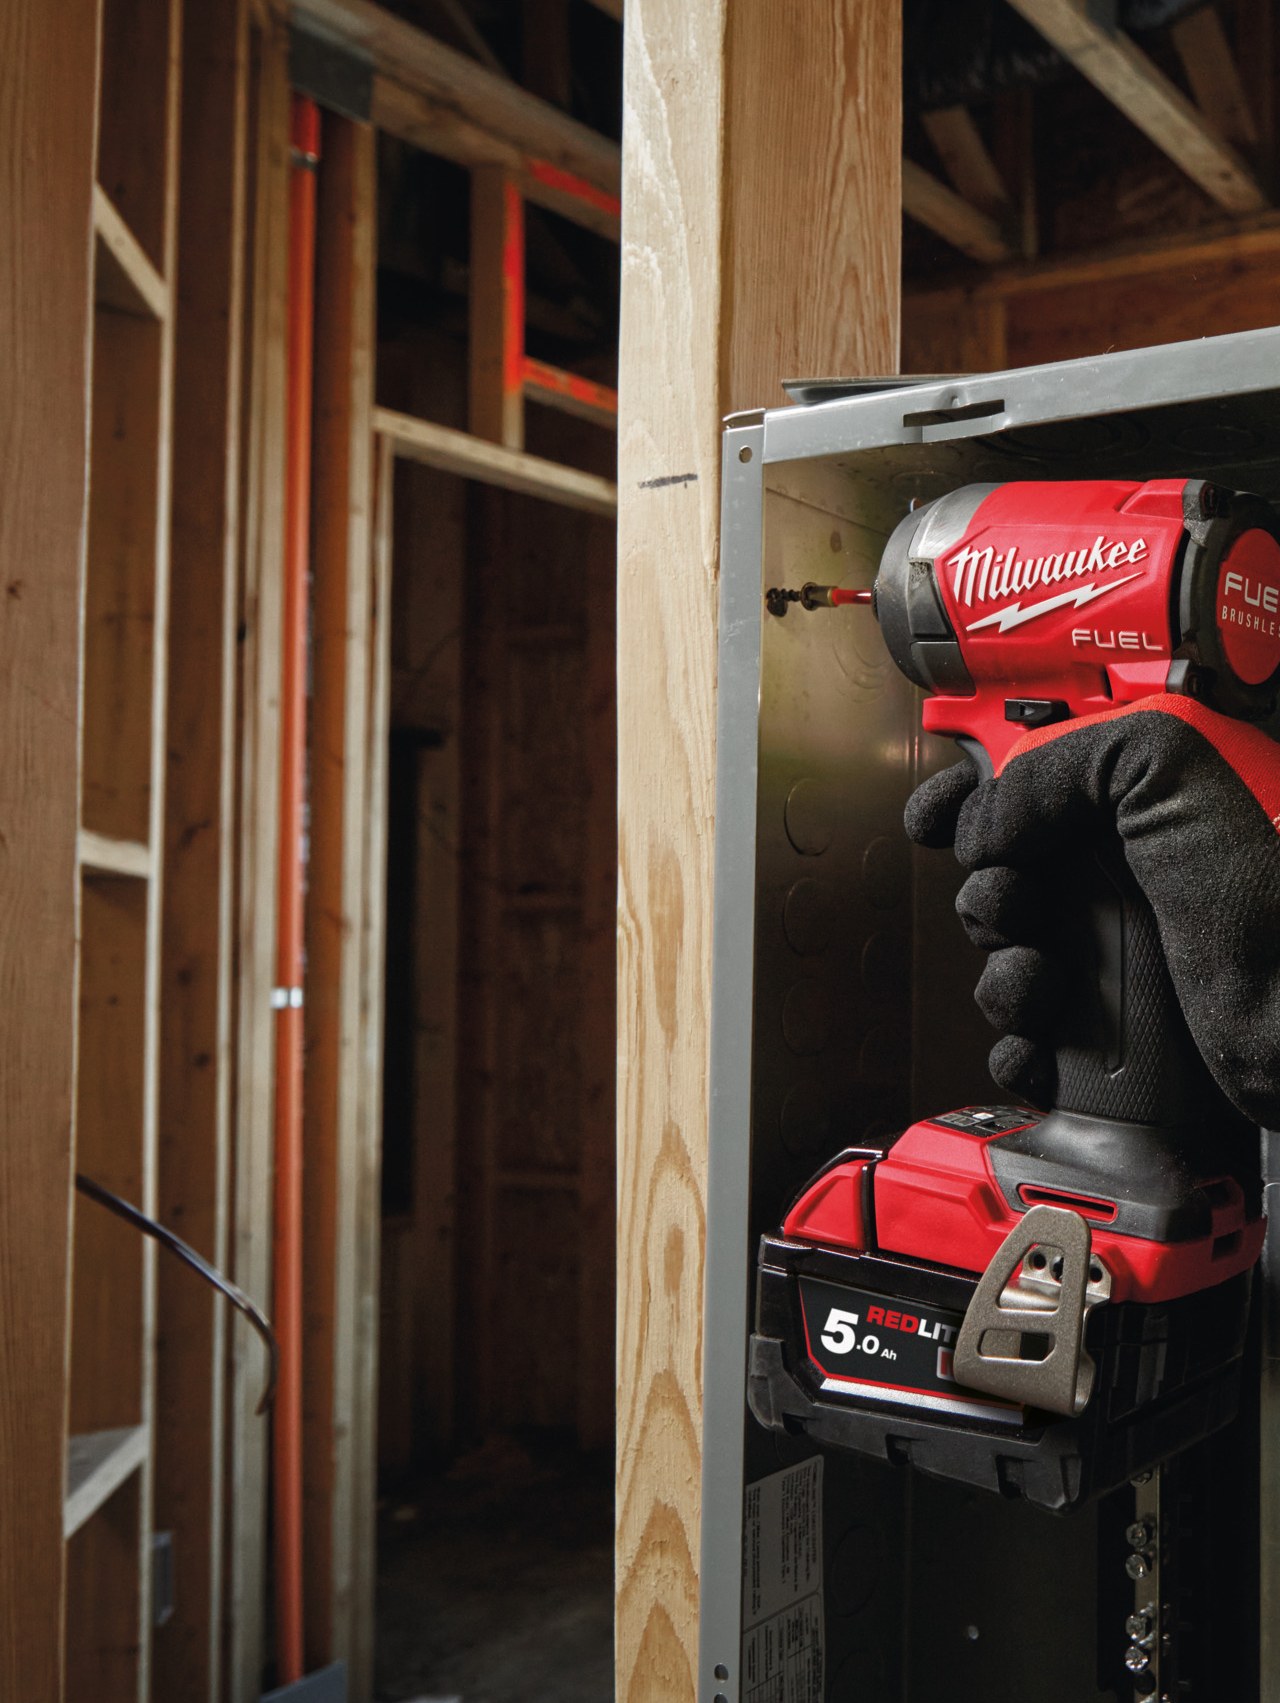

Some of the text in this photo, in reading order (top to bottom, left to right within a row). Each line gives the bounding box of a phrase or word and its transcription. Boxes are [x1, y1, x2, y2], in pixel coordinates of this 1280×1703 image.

[947, 535, 1148, 608] Milwaukee
[1071, 627, 1164, 651] FUEL
[820, 1307, 897, 1361] 5.0 Ah
[866, 1304, 957, 1344] REDLIT
